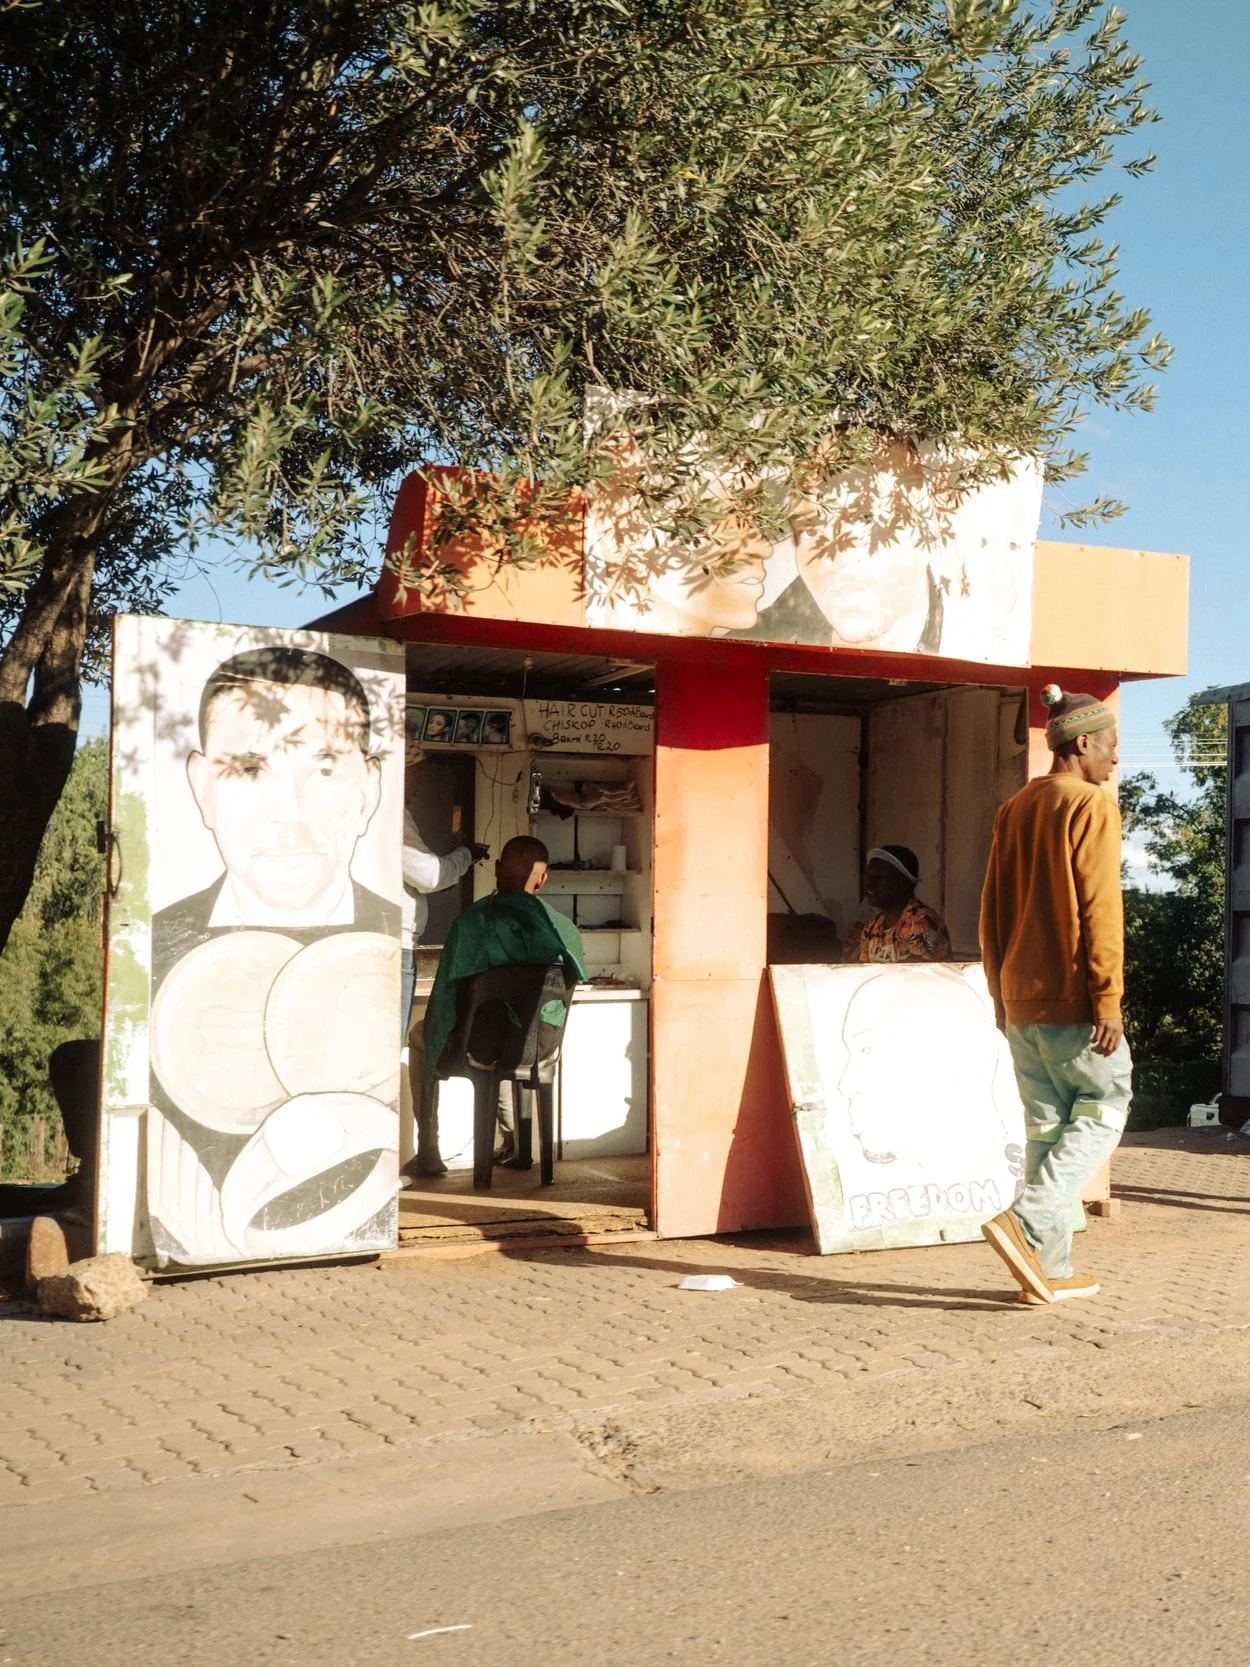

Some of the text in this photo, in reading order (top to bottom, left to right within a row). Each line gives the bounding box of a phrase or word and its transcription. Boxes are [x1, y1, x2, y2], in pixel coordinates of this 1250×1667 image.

[538, 702, 576, 719] HAIR
[543, 719, 596, 731] CHISKOP
[849, 1179, 1001, 1230] FREEDOM
